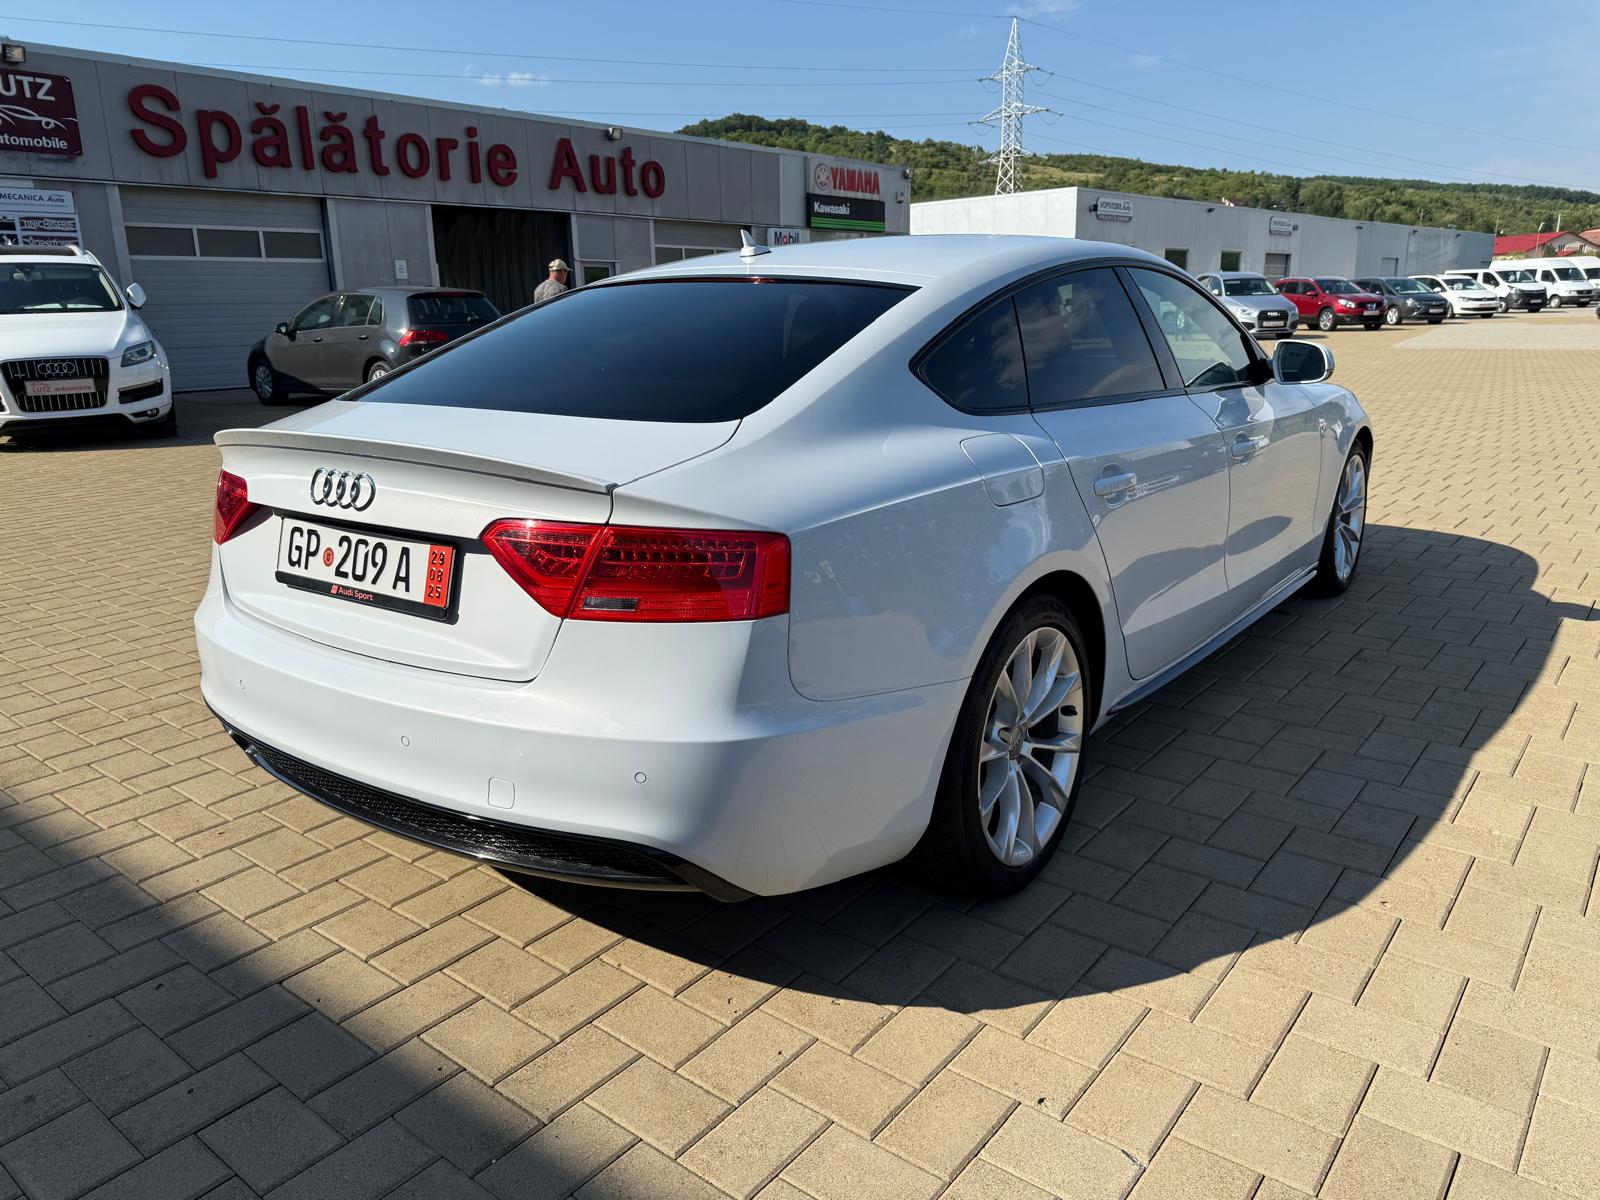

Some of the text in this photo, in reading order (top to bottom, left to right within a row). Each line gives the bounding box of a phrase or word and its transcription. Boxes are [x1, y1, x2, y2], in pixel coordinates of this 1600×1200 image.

[128, 84, 666, 198] Spălătorie Auto
[831, 167, 880, 195] YAMAHA
[0, 193, 45, 202] MECANICA
[813, 201, 850, 215] Kawasaki
[774, 231, 800, 246] Mobil
[287, 527, 411, 593] GP 209 A
[431, 550, 445, 566] 29
[429, 567, 443, 583] 08
[338, 586, 374, 601] Audi Sport
[427, 584, 442, 599] 25
